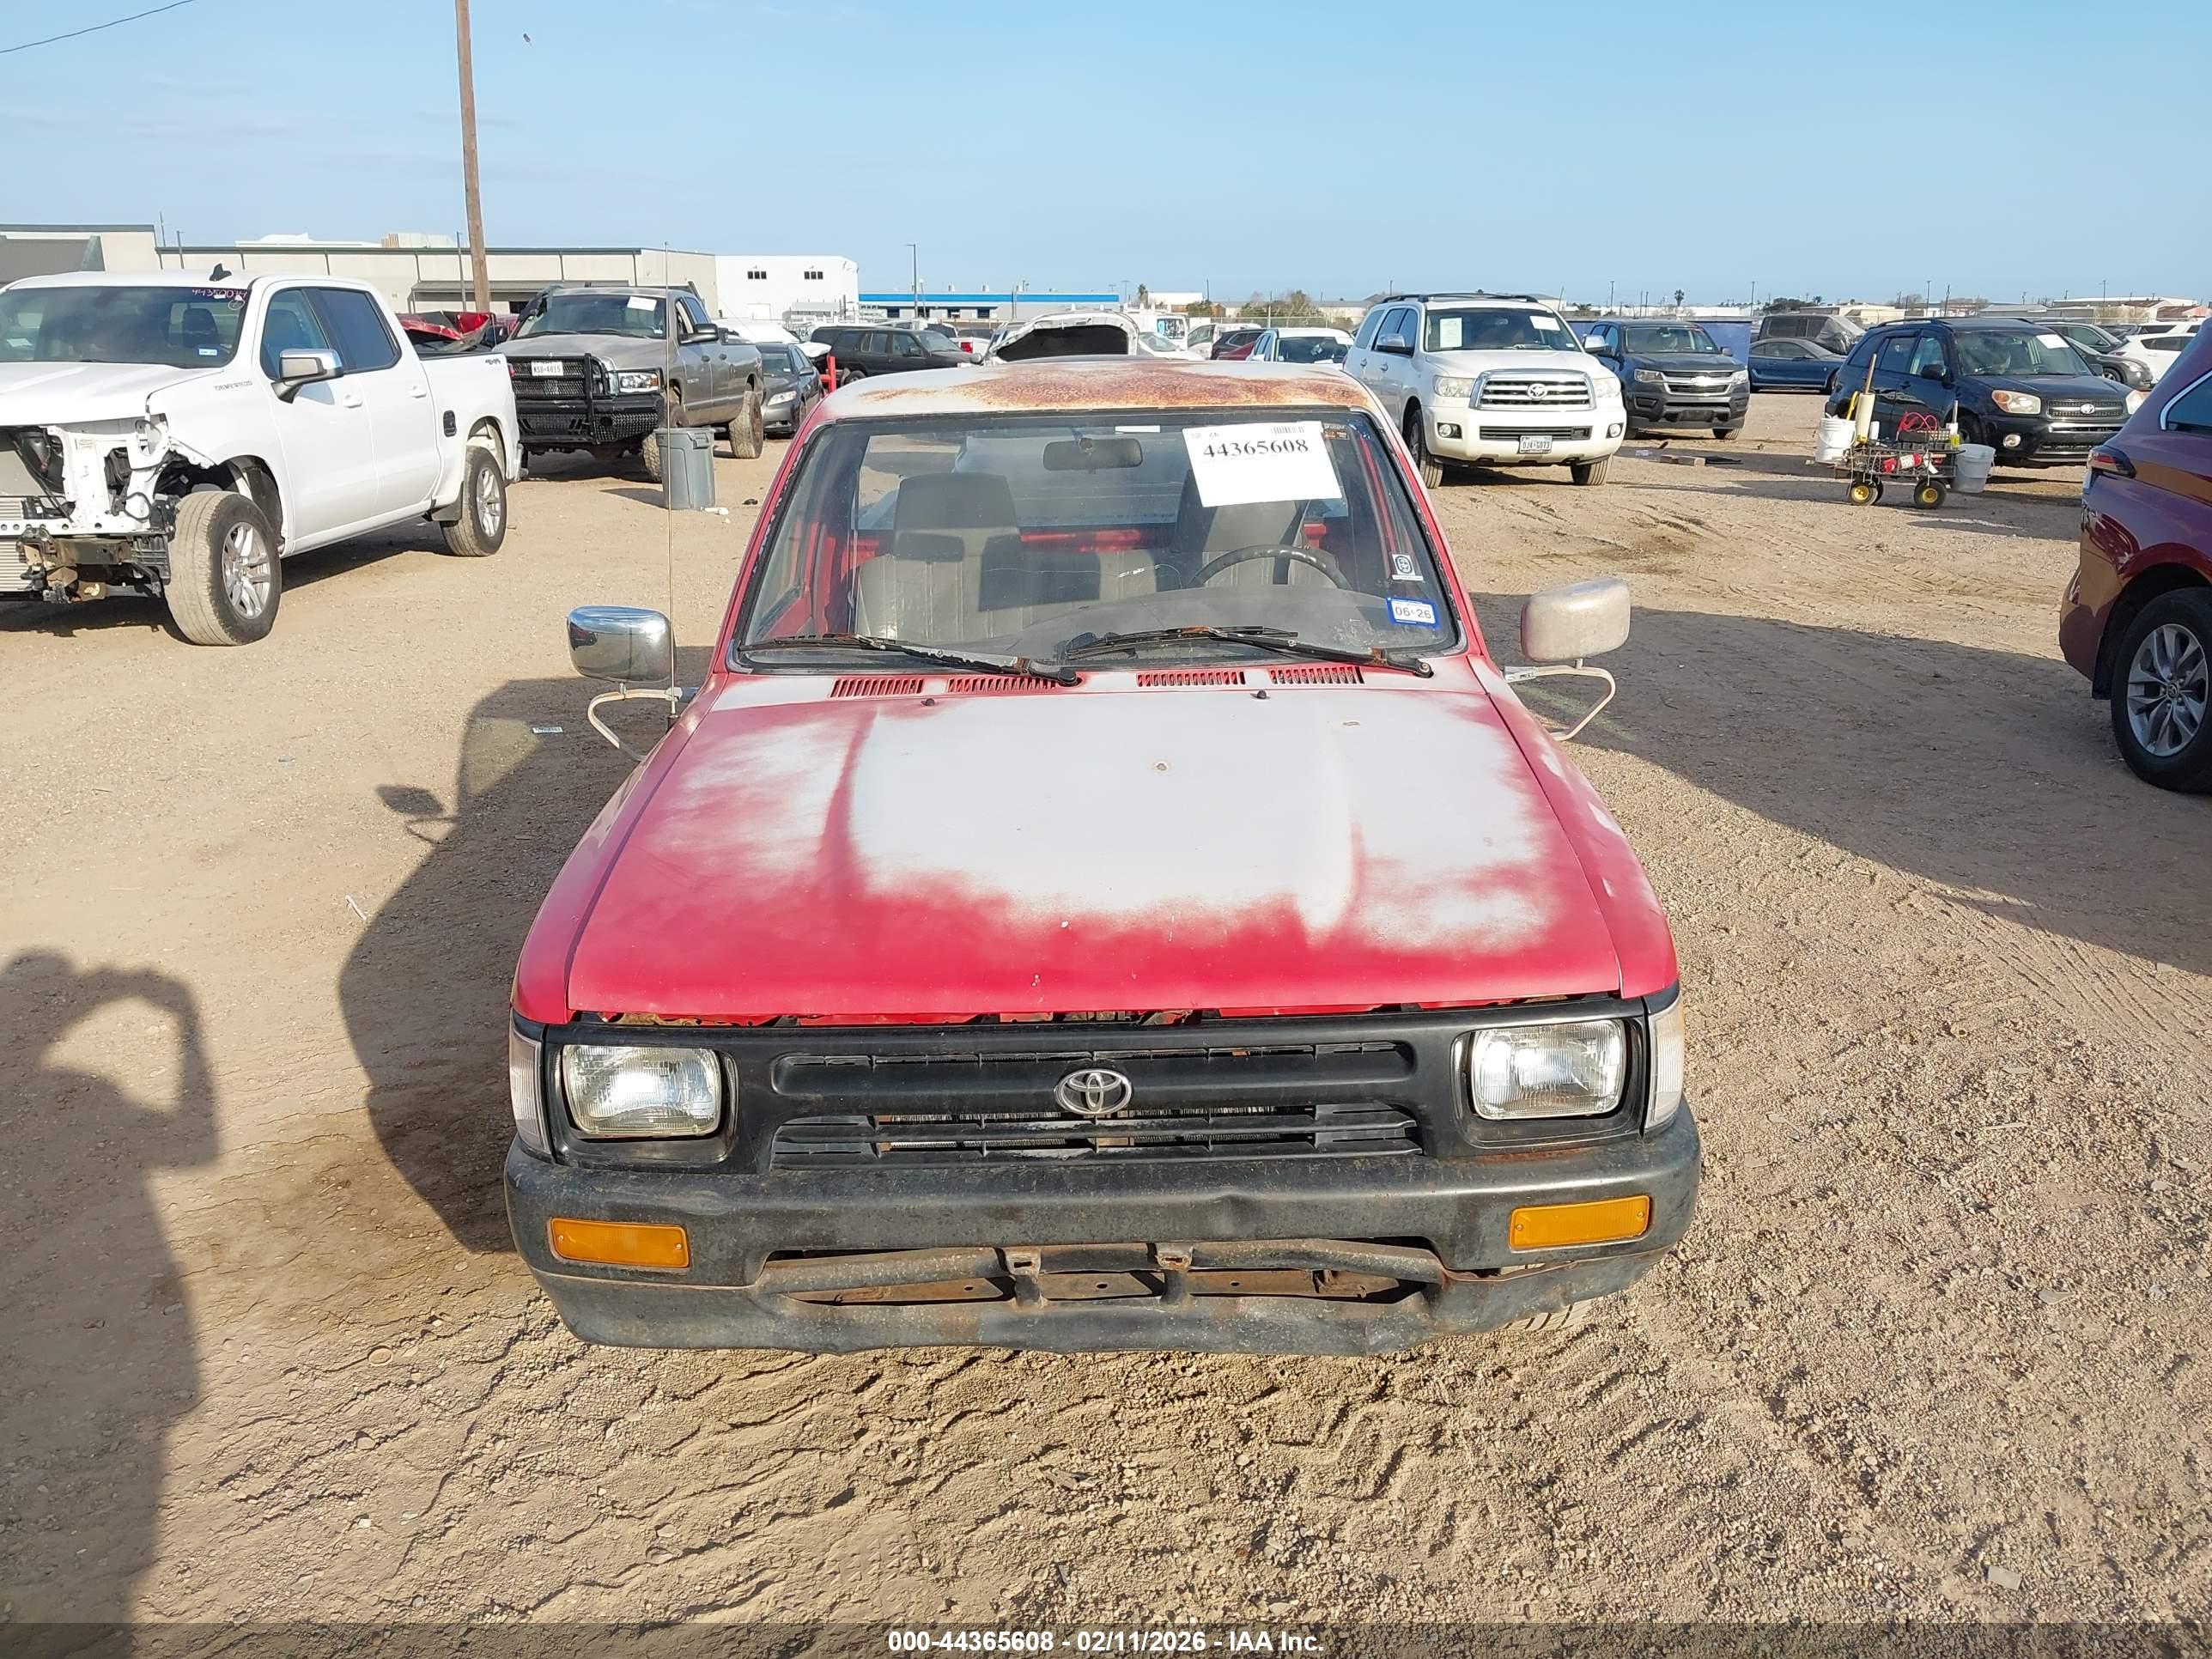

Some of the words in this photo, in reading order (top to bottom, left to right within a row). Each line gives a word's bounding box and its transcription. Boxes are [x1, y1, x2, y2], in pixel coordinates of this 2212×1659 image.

[1203, 439, 1309, 458] 44365608
[1395, 605, 1411, 617] 06
[1416, 608, 1432, 619] 26
